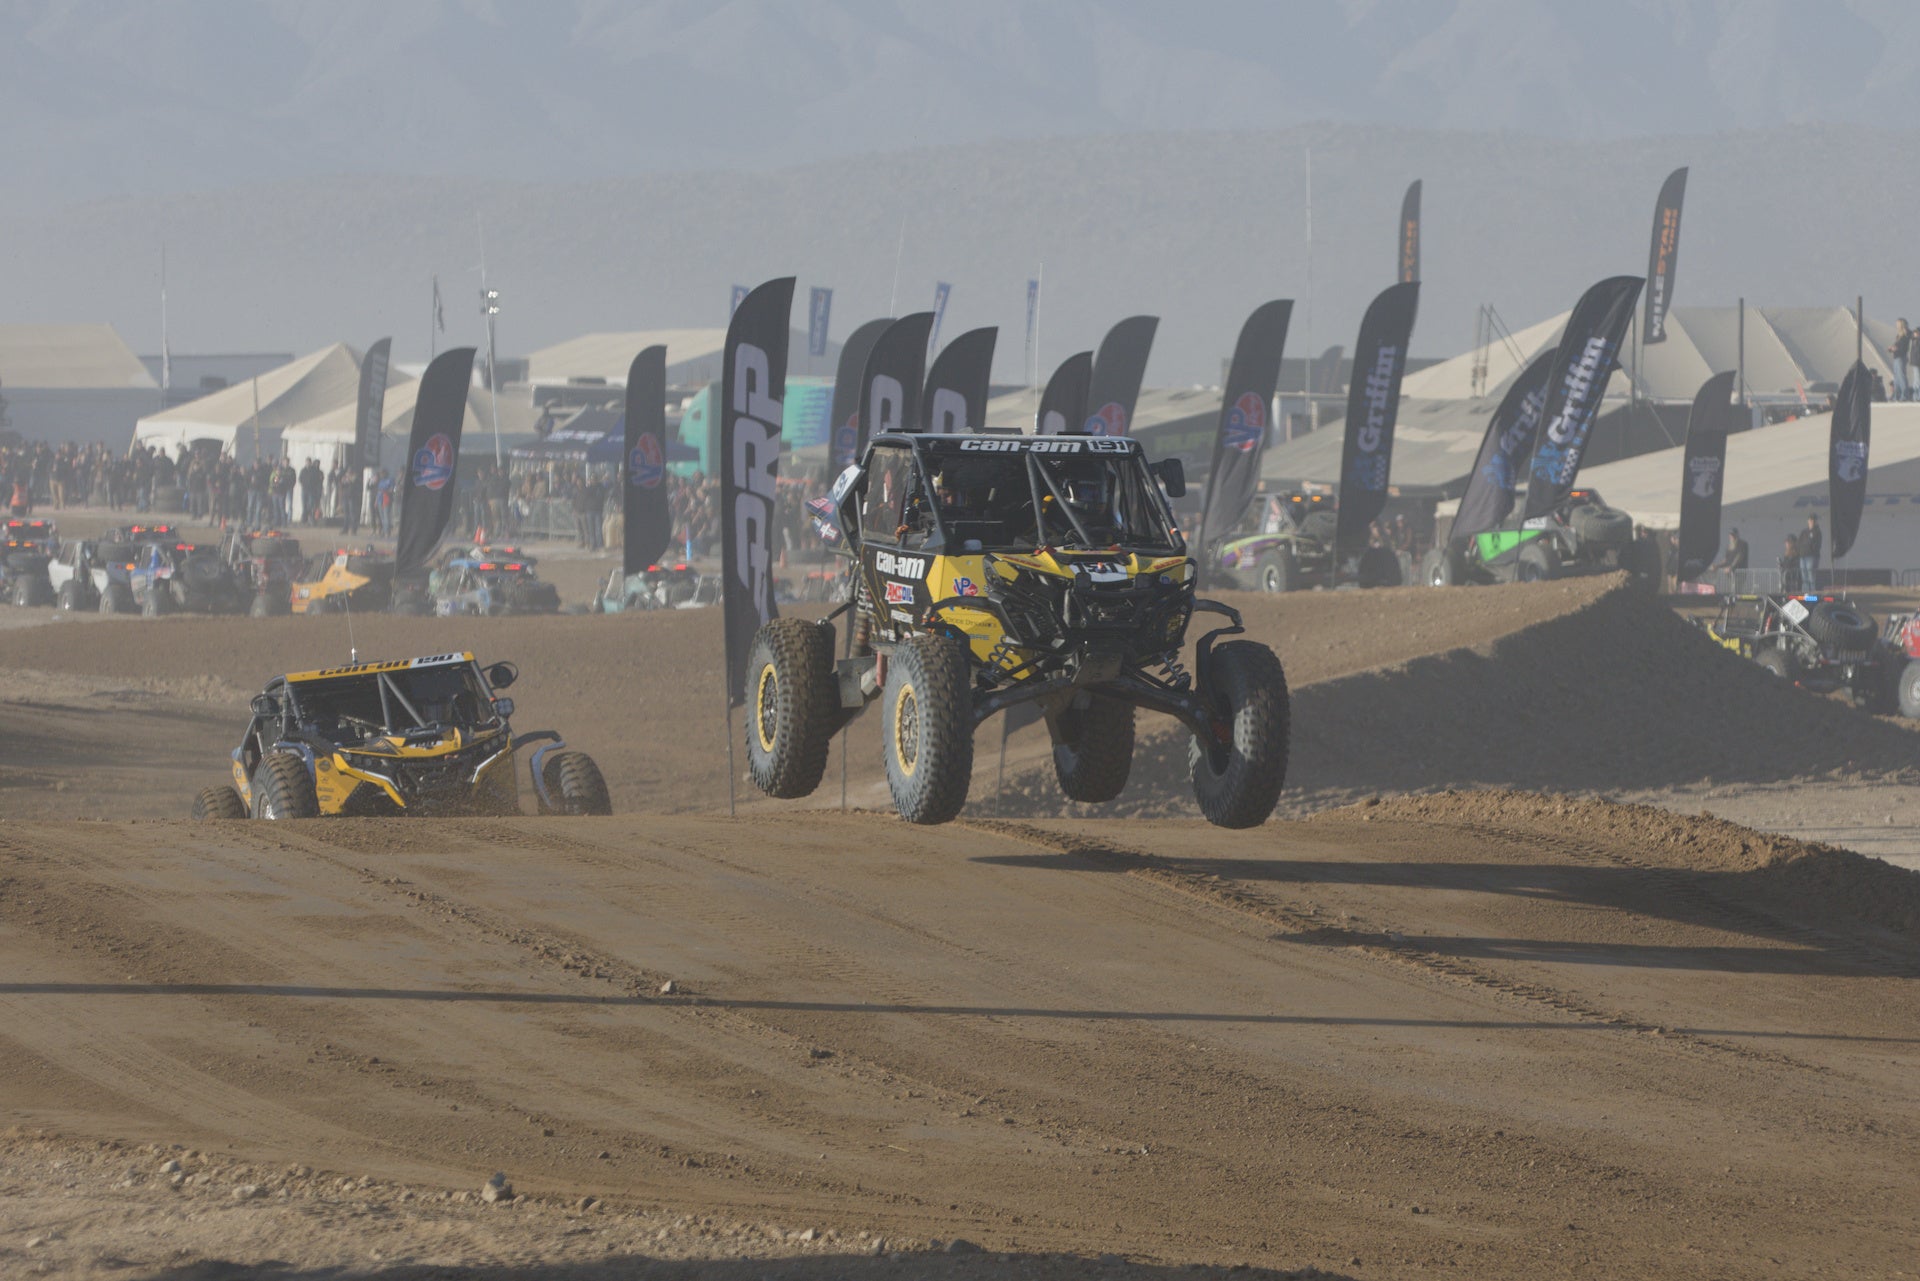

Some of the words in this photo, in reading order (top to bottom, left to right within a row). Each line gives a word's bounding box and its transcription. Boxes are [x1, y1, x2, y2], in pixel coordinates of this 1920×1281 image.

[1651, 207, 1670, 338] MILESTAR
[1357, 345, 1397, 453] Griffin
[1547, 335, 1608, 445] Griffin
[959, 439, 1081, 454] can-am
[1089, 440, 1129, 454] 191
[732, 343, 784, 620] PRP
[876, 550, 926, 580] can-am
[886, 583, 914, 603] AMSOIL
[953, 577, 972, 597] VP
[318, 659, 412, 677] can-am
